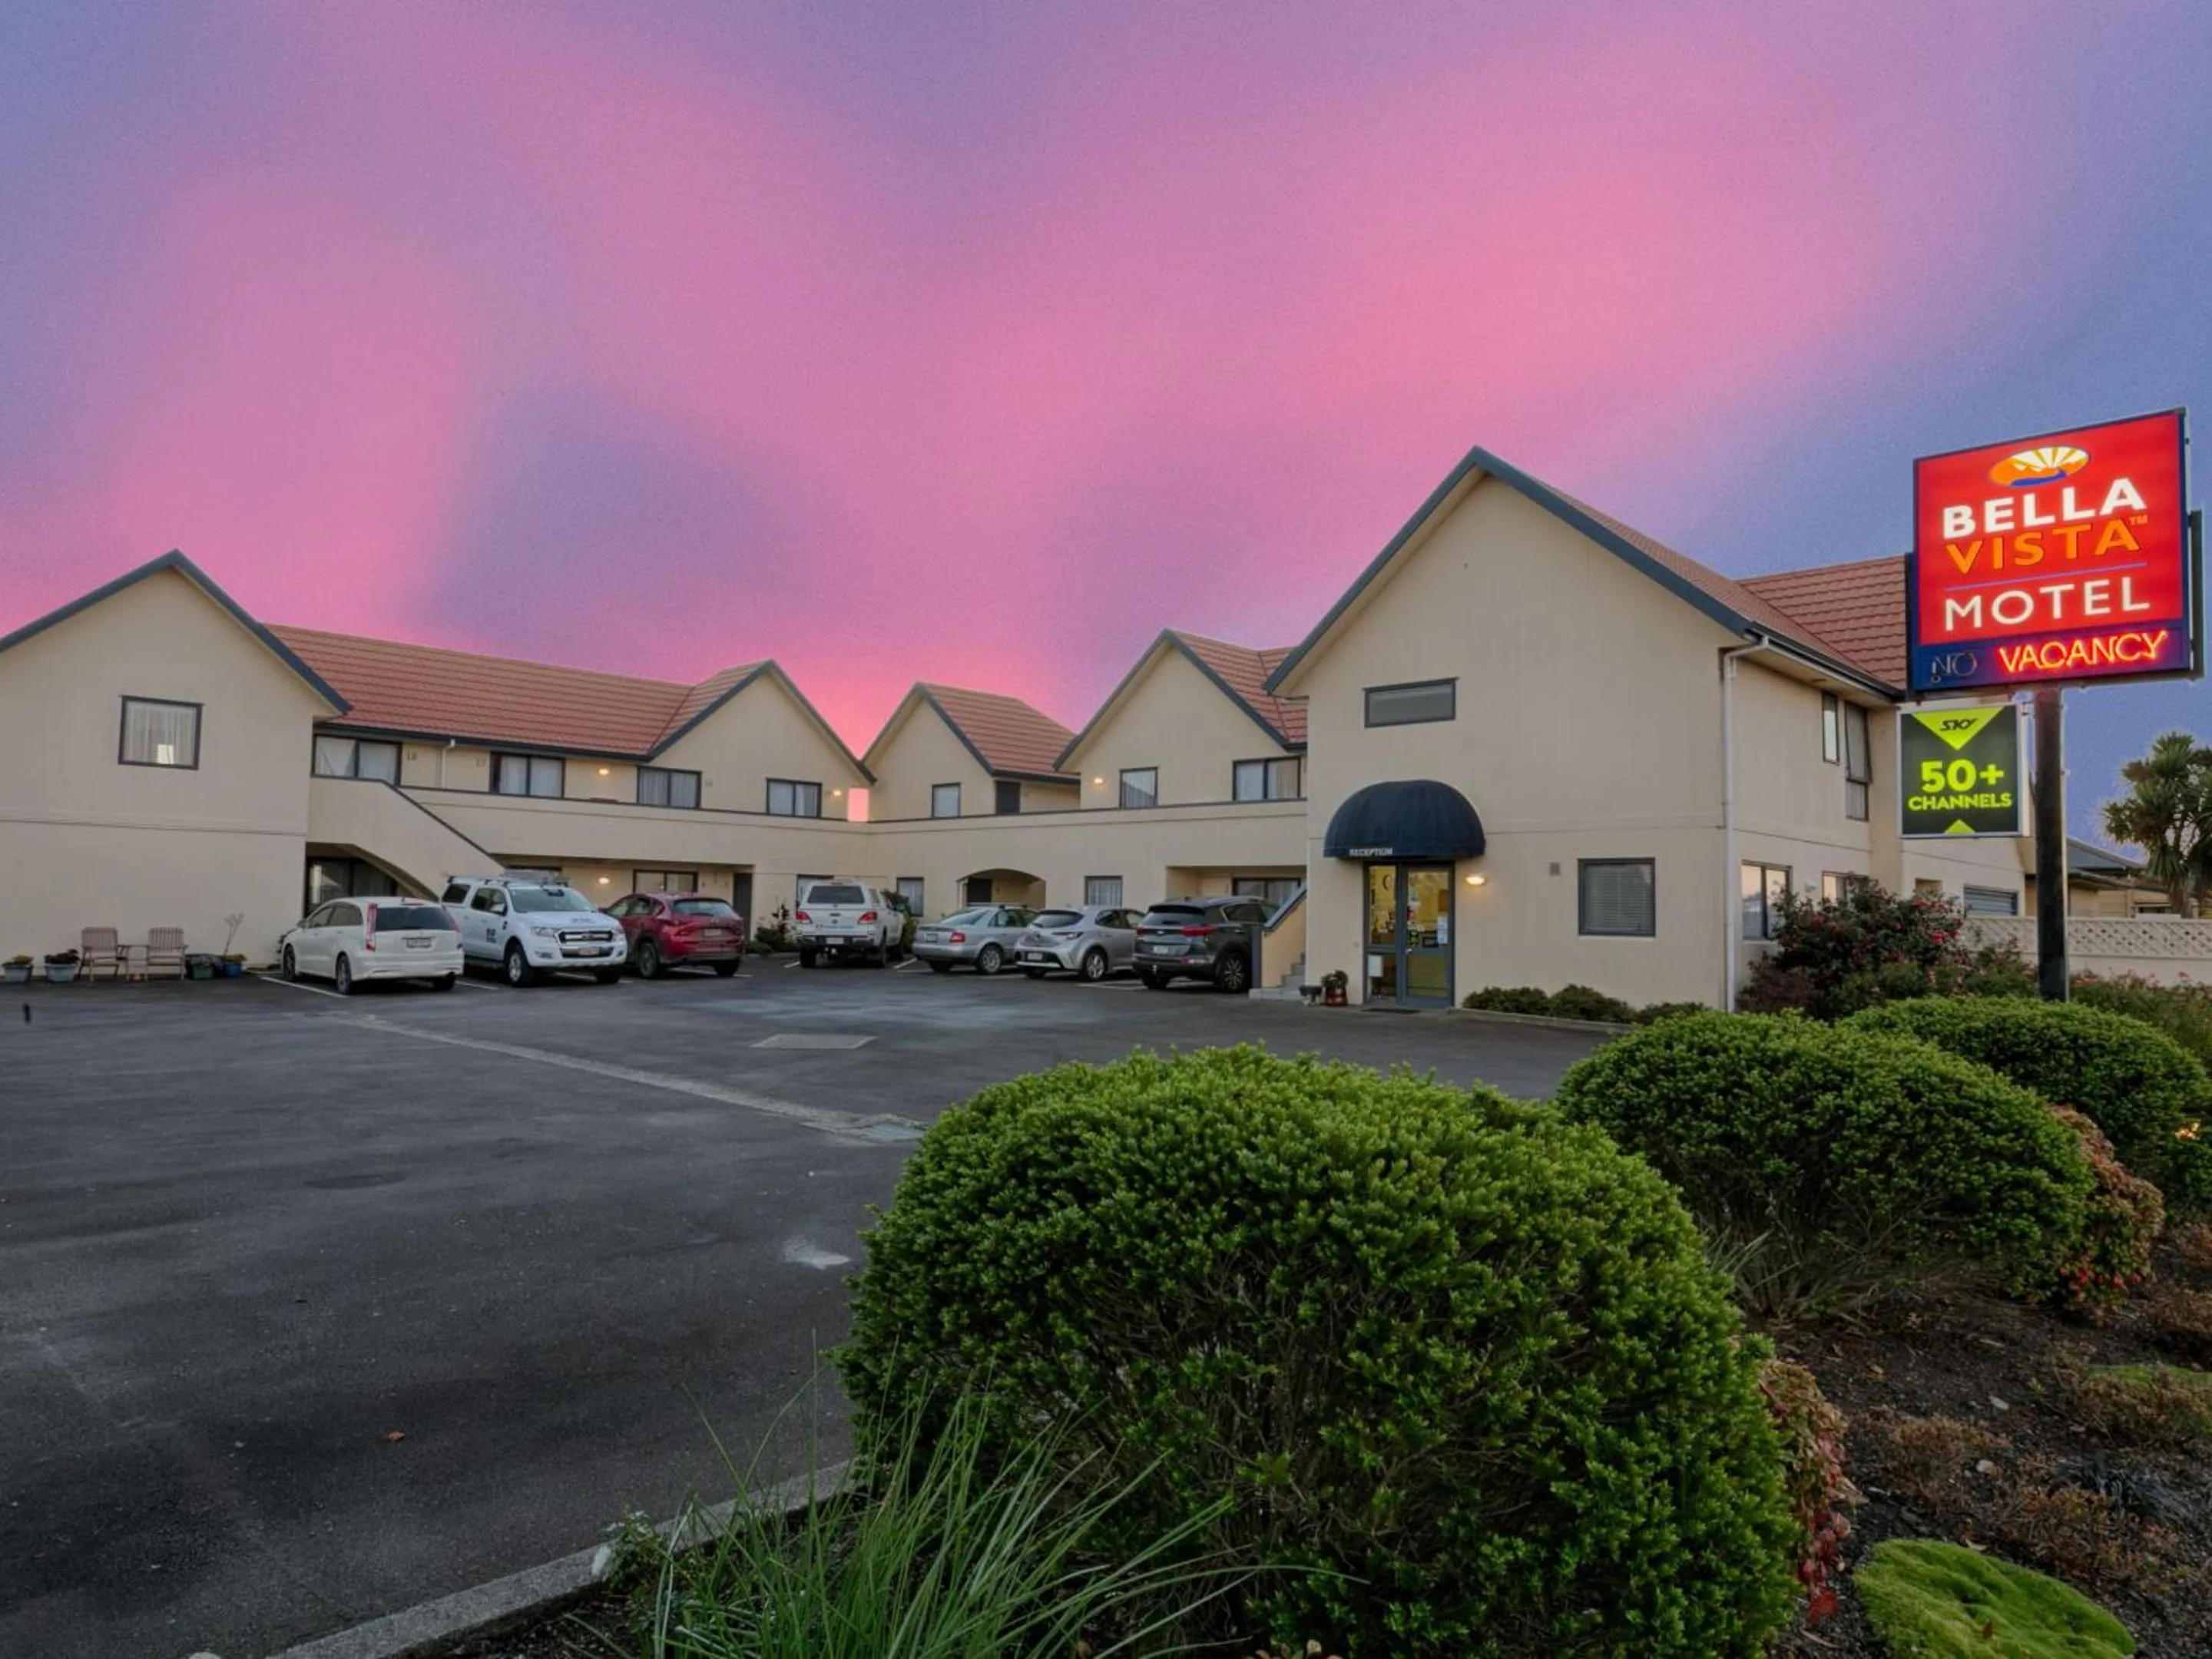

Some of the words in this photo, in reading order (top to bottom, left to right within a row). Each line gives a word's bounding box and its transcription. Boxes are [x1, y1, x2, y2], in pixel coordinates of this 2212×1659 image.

[1943, 478, 2147, 539] BELLA
[1946, 519, 2140, 575] VISTA
[1945, 577, 2150, 631] MOTEL
[1932, 651, 1978, 676] NO
[1999, 631, 2168, 672] VACANCY
[1940, 717, 1979, 731] SKY
[1922, 759, 2005, 793] 50+
[1908, 793, 2012, 810] CHANNELS
[1349, 847, 1393, 856] RECEPTION
